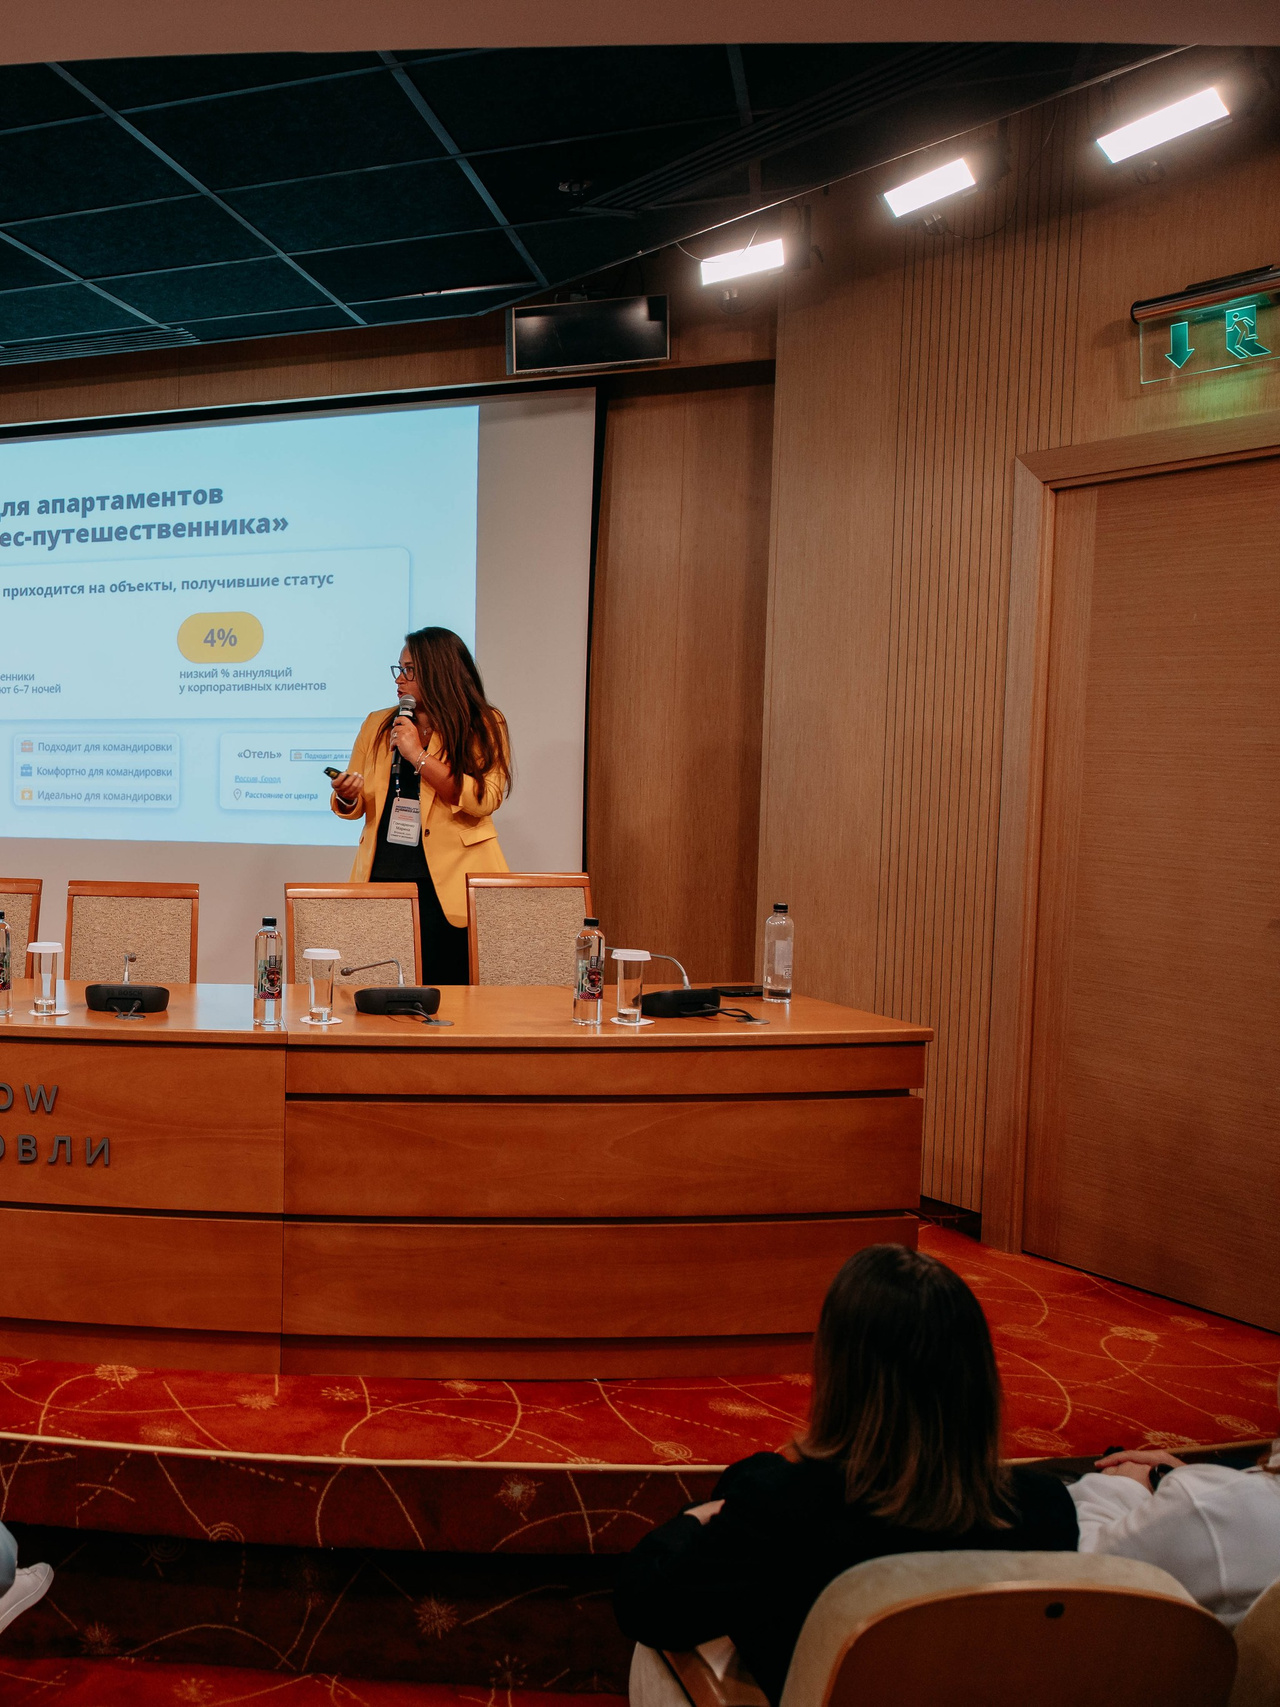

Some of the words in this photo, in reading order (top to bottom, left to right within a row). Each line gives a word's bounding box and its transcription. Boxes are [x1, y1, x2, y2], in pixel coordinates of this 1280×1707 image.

[36, 487, 224, 518] апартаментов
[2, 585, 85, 600] приходится
[88, 584, 106, 594] на
[109, 579, 177, 593] объекты,
[181, 575, 280, 592] получившие
[283, 574, 334, 588] статус
[203, 628, 238, 648] 4%
[179, 668, 218, 679] низкий
[220, 668, 230, 678] %
[232, 666, 293, 680] аннуляций
[31, 683, 62, 694] ночей
[179, 684, 186, 695] у
[187, 683, 272, 694] корпоративных
[274, 681, 327, 691] клиентов
[38, 742, 82, 753] Подходит
[83, 743, 101, 753] для
[102, 743, 173, 754] командировки
[237, 748, 282, 759] «Отель»
[36, 767, 87, 778] Комфортно
[88, 768, 104, 777] для
[106, 768, 173, 778] командировки
[37, 790, 82, 800] Идеально
[83, 791, 101, 802] для
[103, 792, 172, 803] командировки
[245, 791, 284, 799] Расстояние
